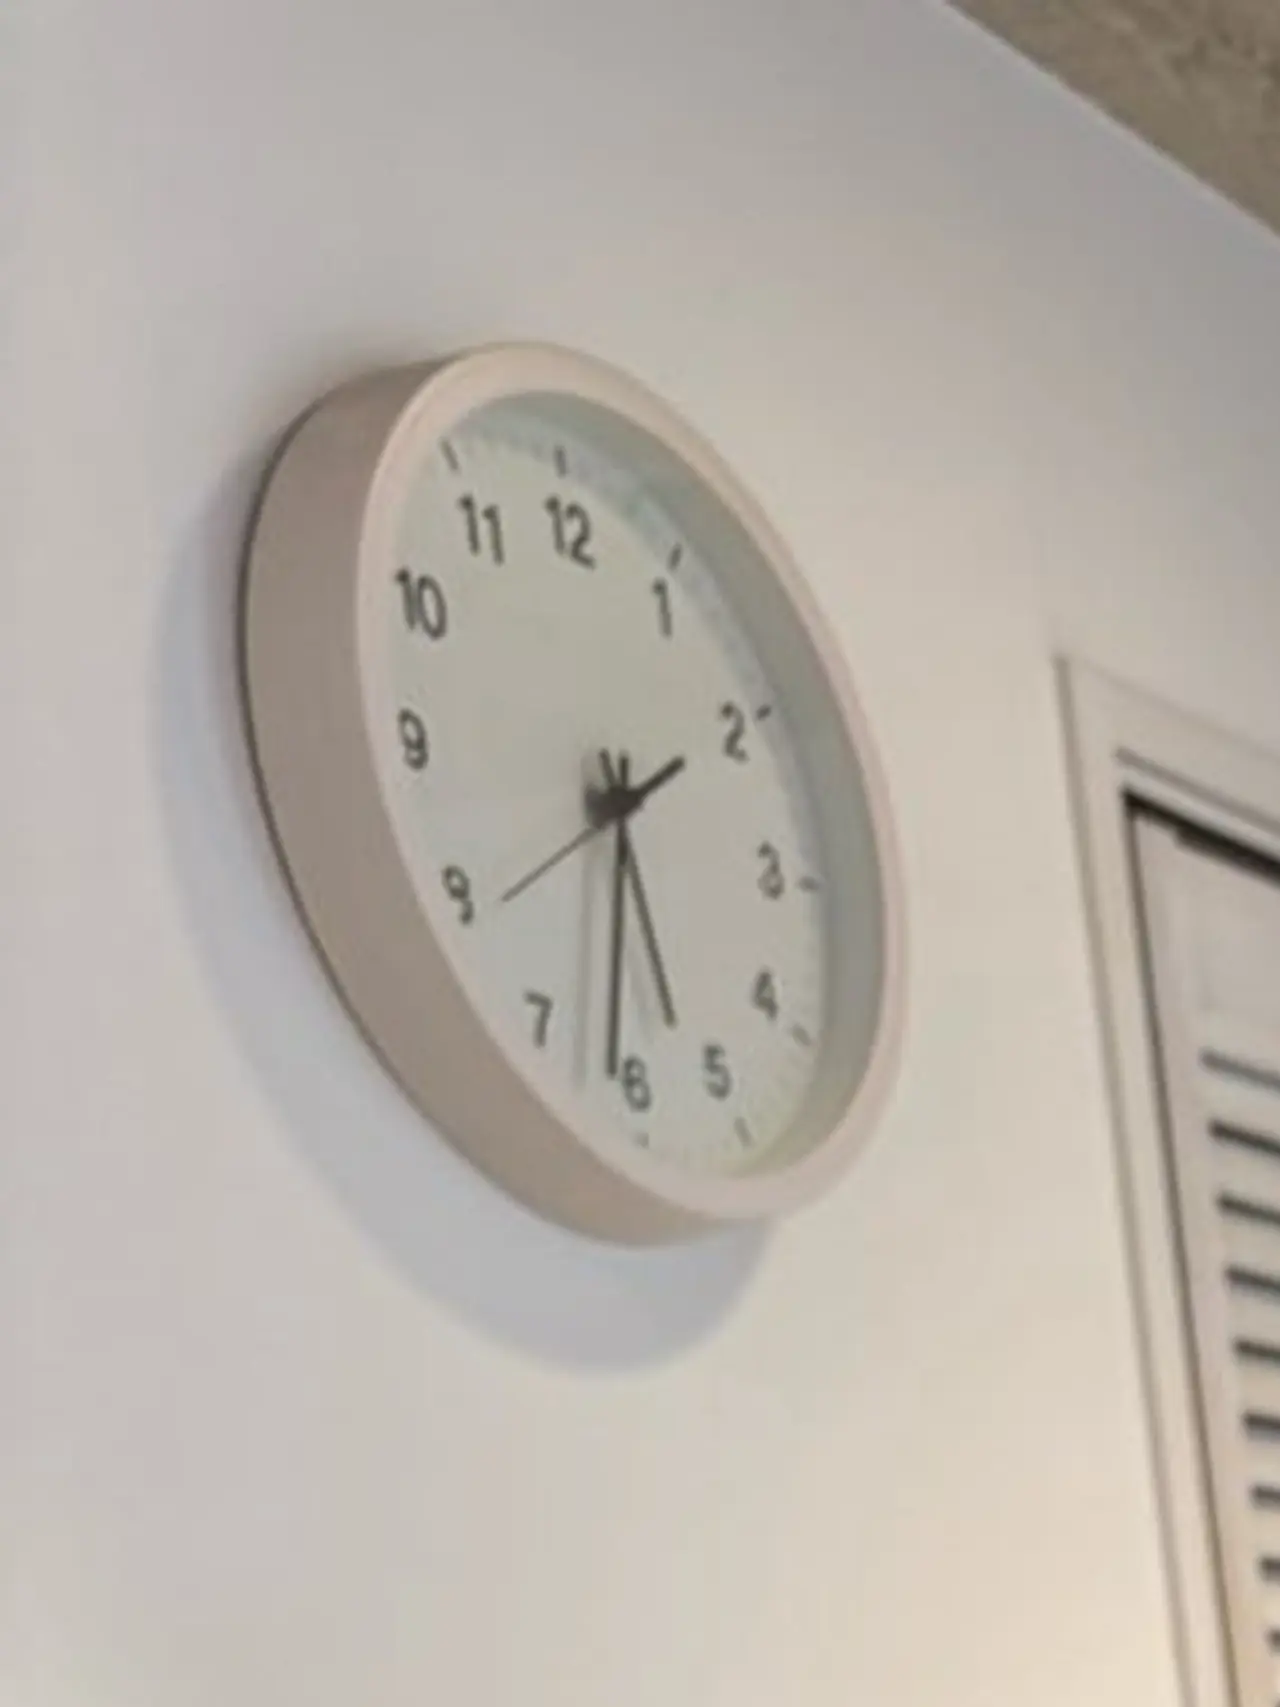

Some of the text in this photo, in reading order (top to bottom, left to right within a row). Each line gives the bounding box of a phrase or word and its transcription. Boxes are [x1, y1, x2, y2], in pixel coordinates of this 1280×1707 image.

[460, 495, 504, 566] 11
[547, 495, 597, 570] 12
[397, 568, 447, 640] 10
[653, 578, 672, 638] 1
[398, 708, 429, 770] 9
[721, 703, 748, 763] 2
[757, 842, 785, 899] 3
[526, 990, 553, 1048] 7
[752, 971, 779, 1021] 4
[623, 1055, 652, 1111] 6
[704, 1044, 732, 1100] 5
